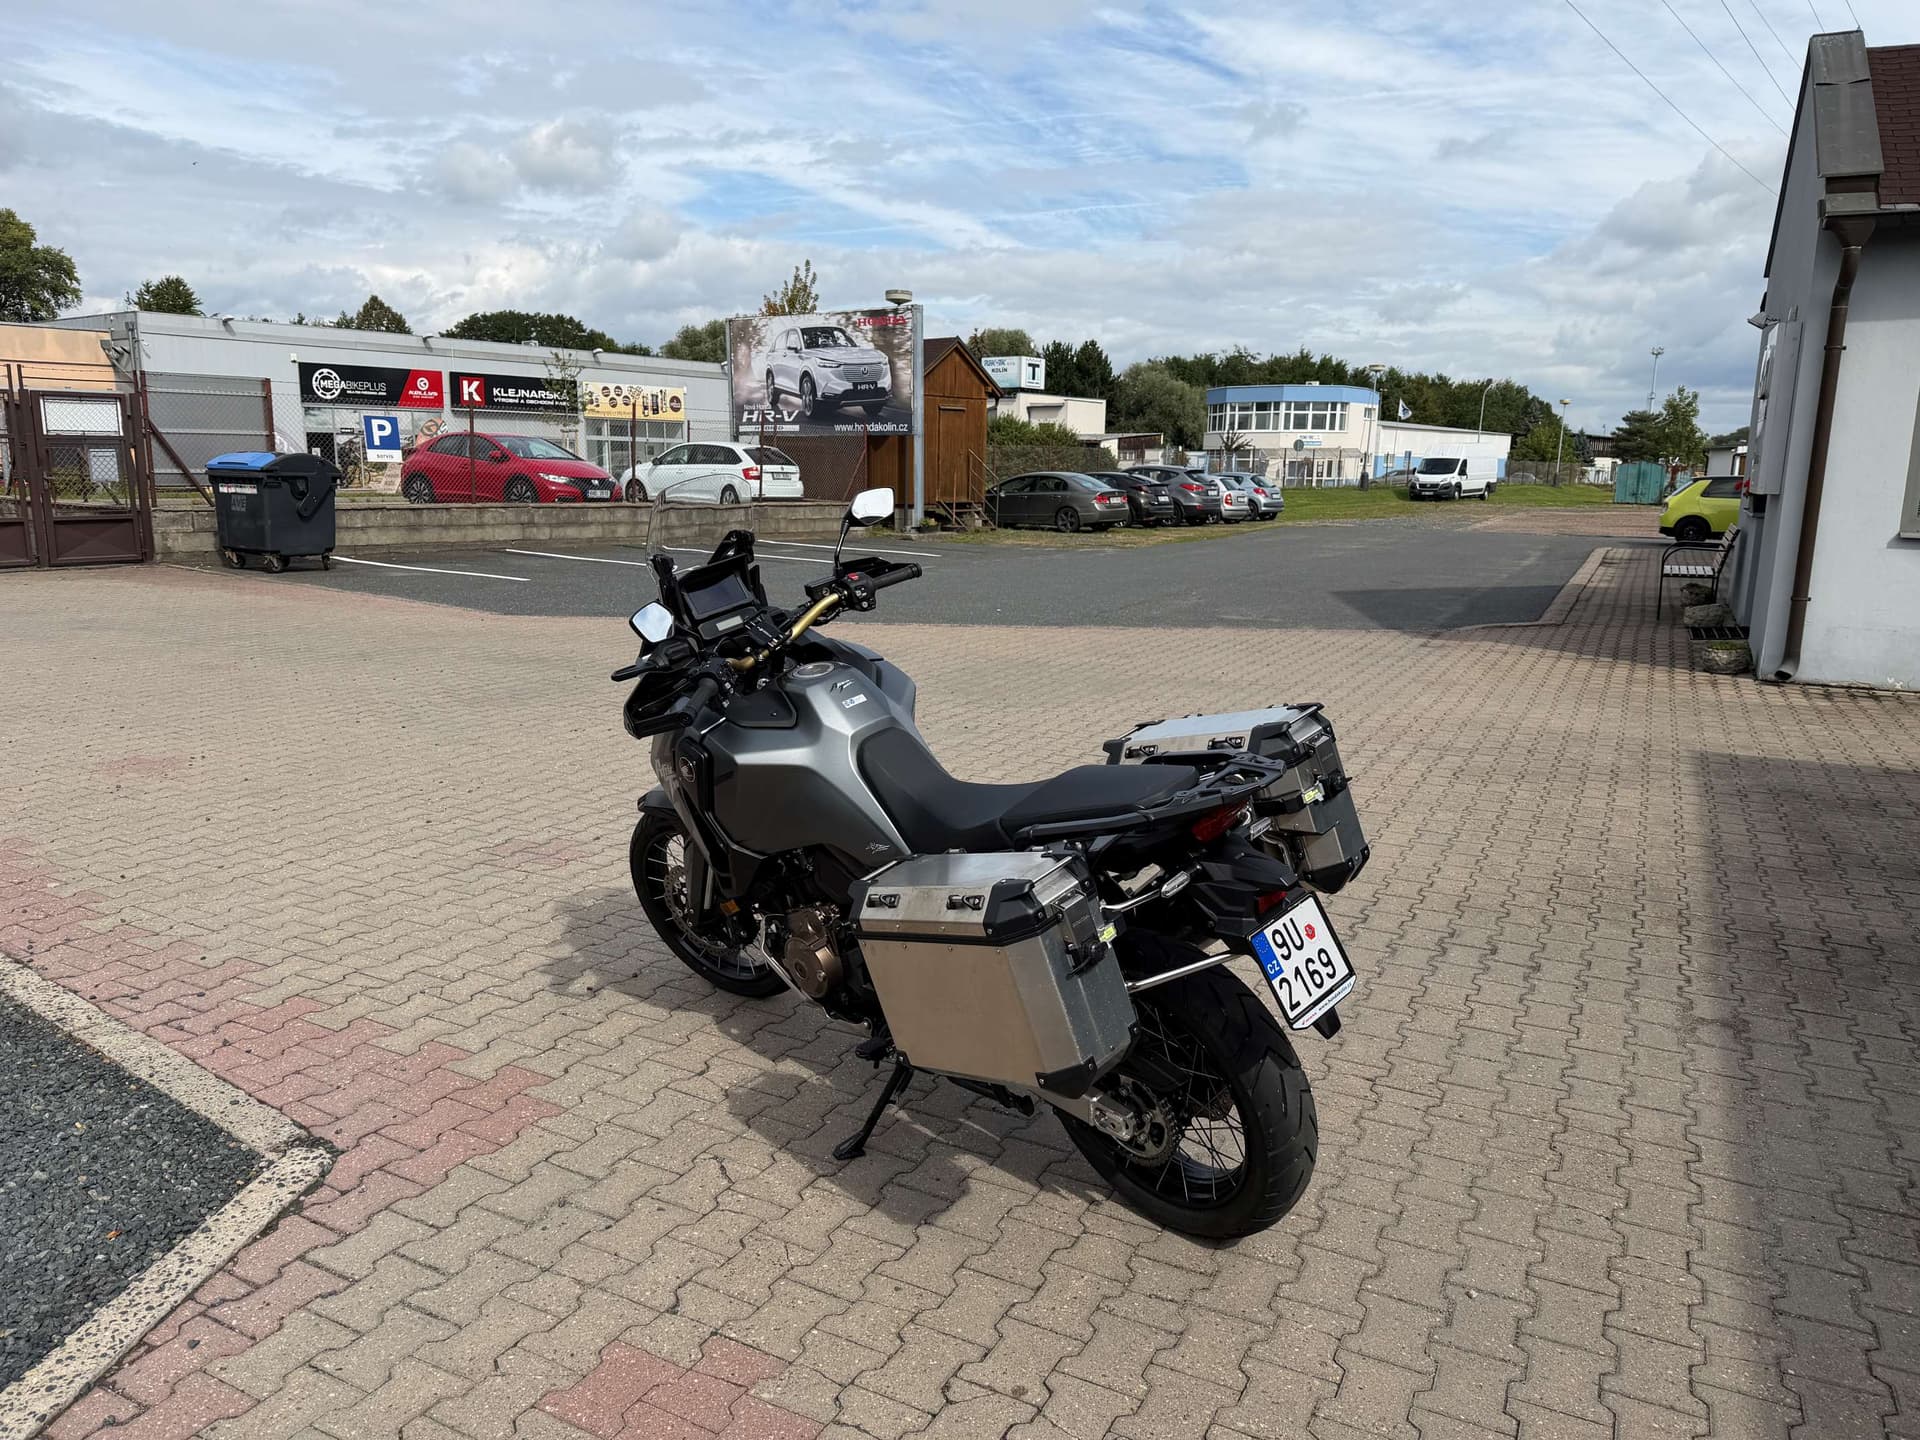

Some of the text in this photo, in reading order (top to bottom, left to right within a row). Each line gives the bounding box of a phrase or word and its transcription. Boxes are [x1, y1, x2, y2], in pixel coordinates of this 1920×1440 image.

[462, 379, 482, 402] K
[370, 418, 392, 447] P
[1271, 917, 1305, 961] 9U
[1266, 959, 1281, 975] CZ
[1278, 947, 1337, 1012] 2169
